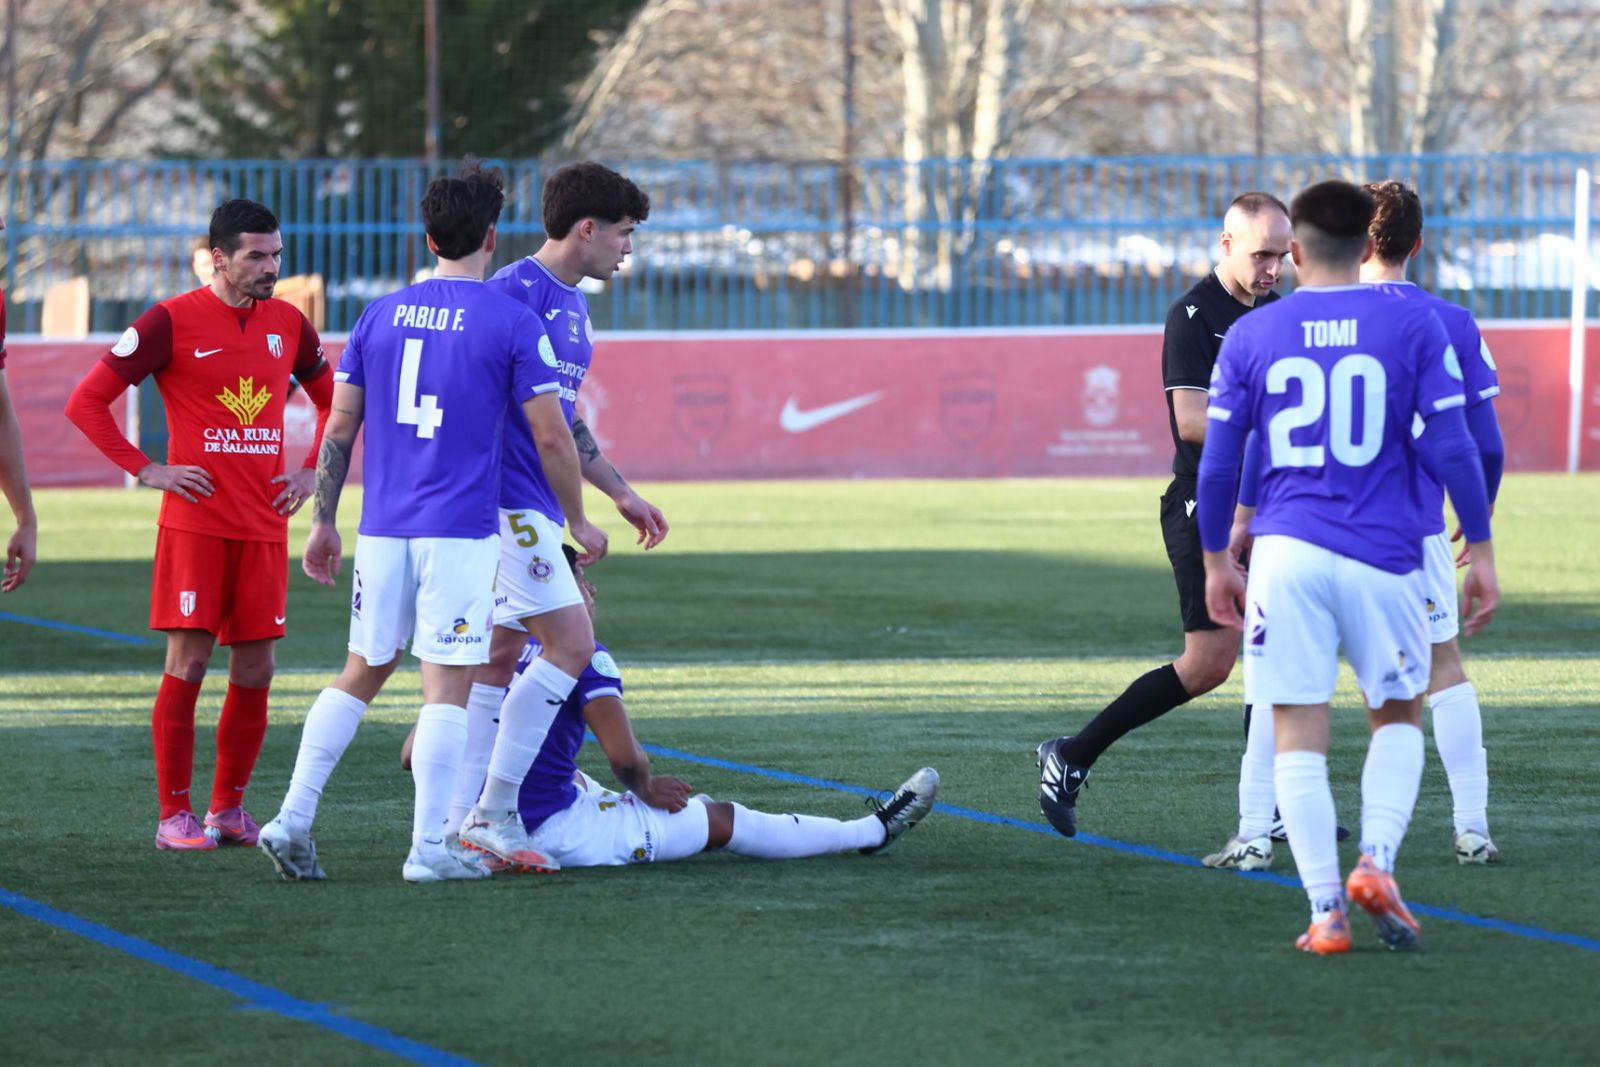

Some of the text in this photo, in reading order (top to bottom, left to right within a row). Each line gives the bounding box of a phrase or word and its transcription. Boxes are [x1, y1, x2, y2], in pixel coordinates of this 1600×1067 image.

[393, 304, 465, 331] PABLO F.
[1301, 319, 1357, 348] TOMI
[396, 338, 444, 439] 4
[1266, 353, 1387, 468] 20
[203, 428, 240, 443] CAJA
[204, 442, 221, 452] DE
[507, 513, 539, 548] 5
